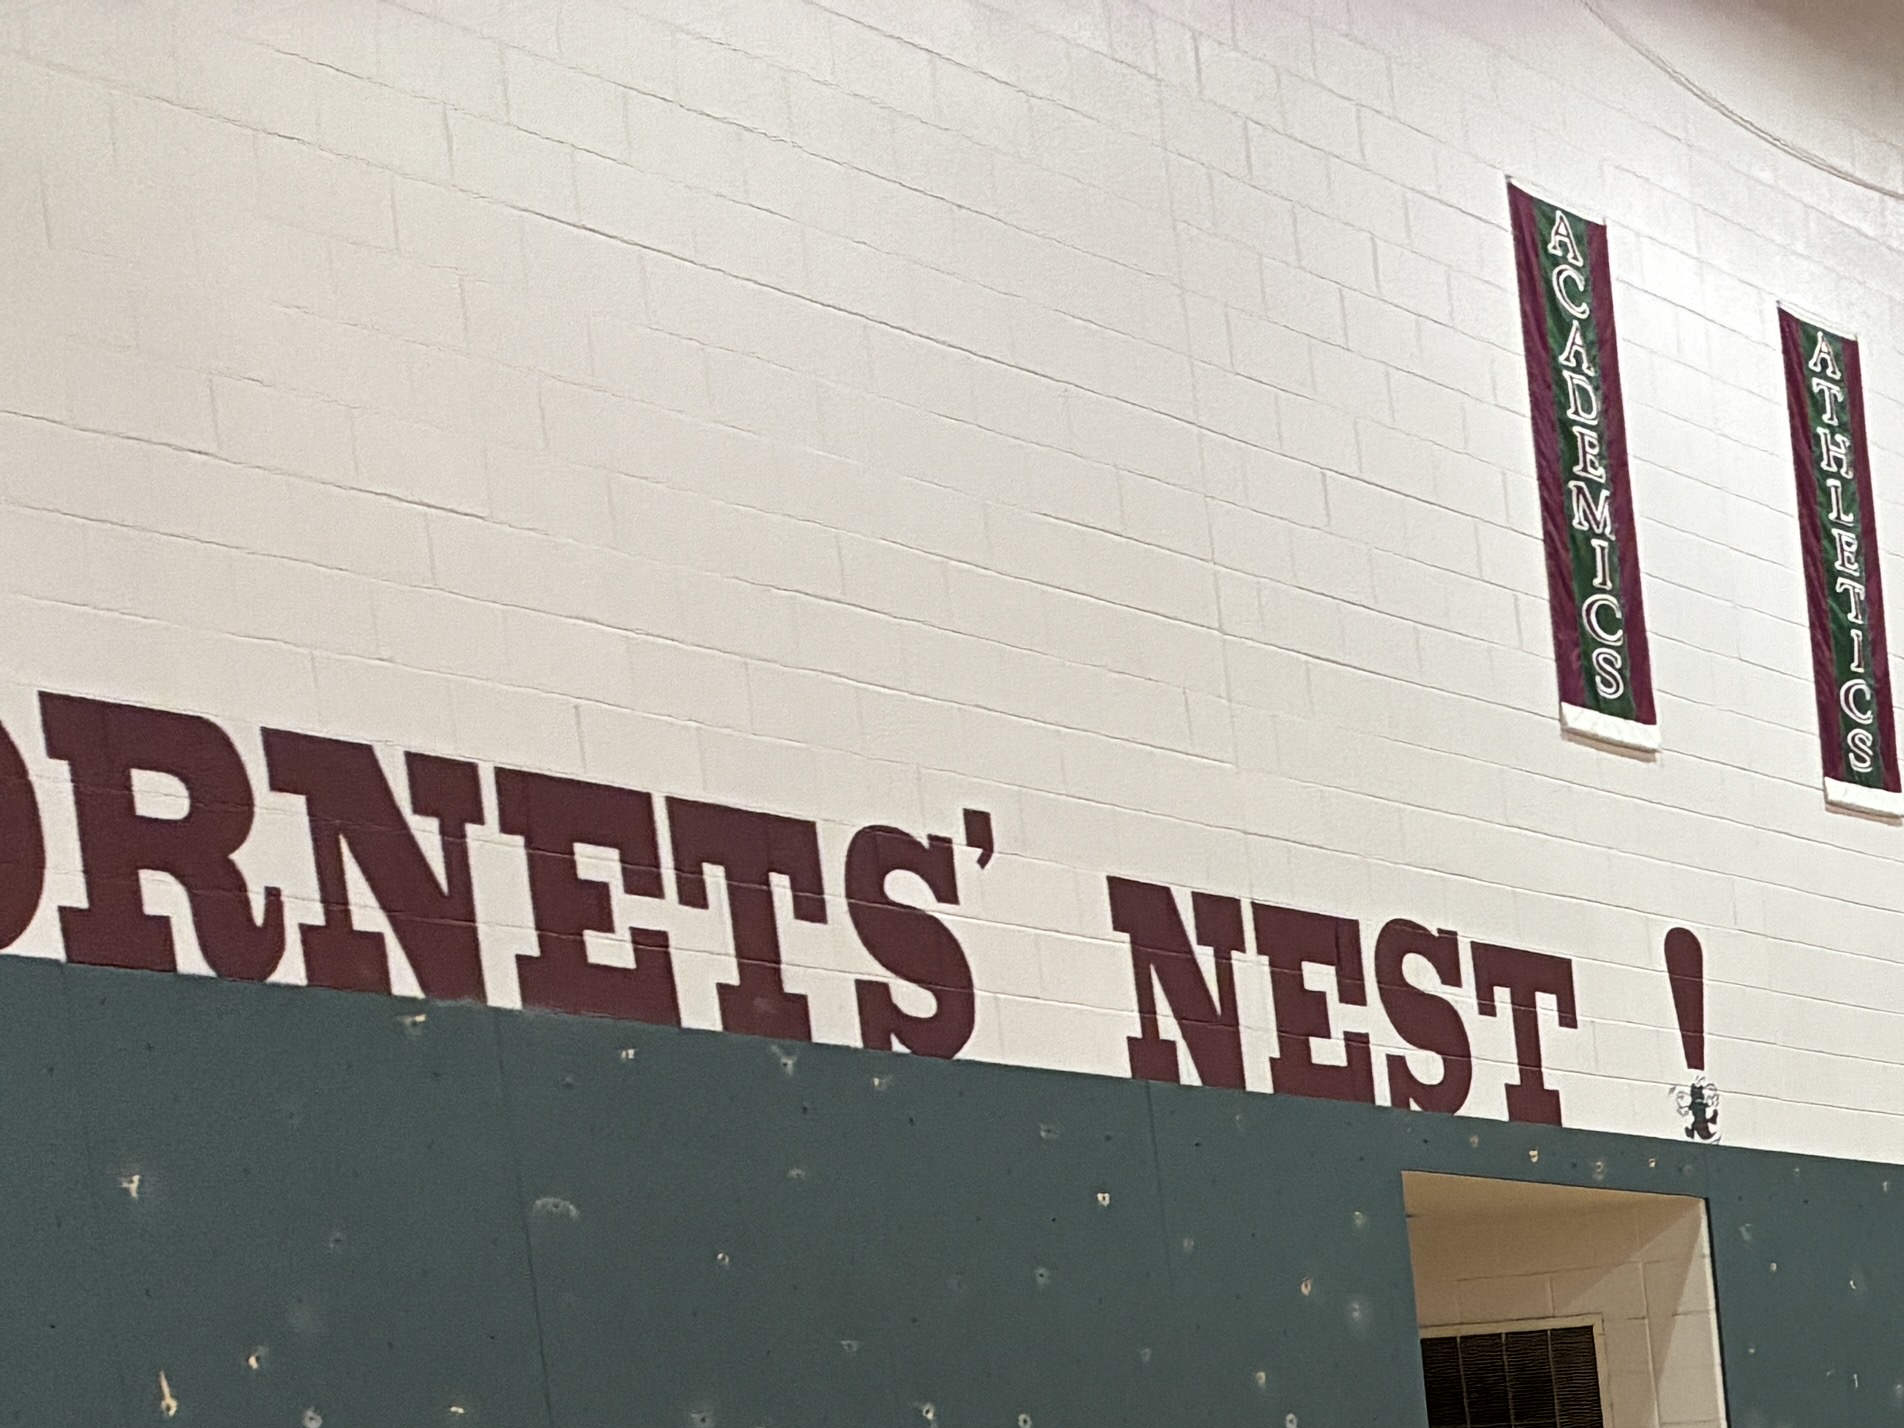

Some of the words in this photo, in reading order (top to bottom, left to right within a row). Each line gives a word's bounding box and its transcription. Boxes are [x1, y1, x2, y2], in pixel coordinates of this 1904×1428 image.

[1545, 209, 1625, 700] ACADEMICS
[1808, 331, 1874, 773] ATHLETICS
[0, 690, 996, 1060] RNETS'
[1106, 875, 1579, 1128] NEST
